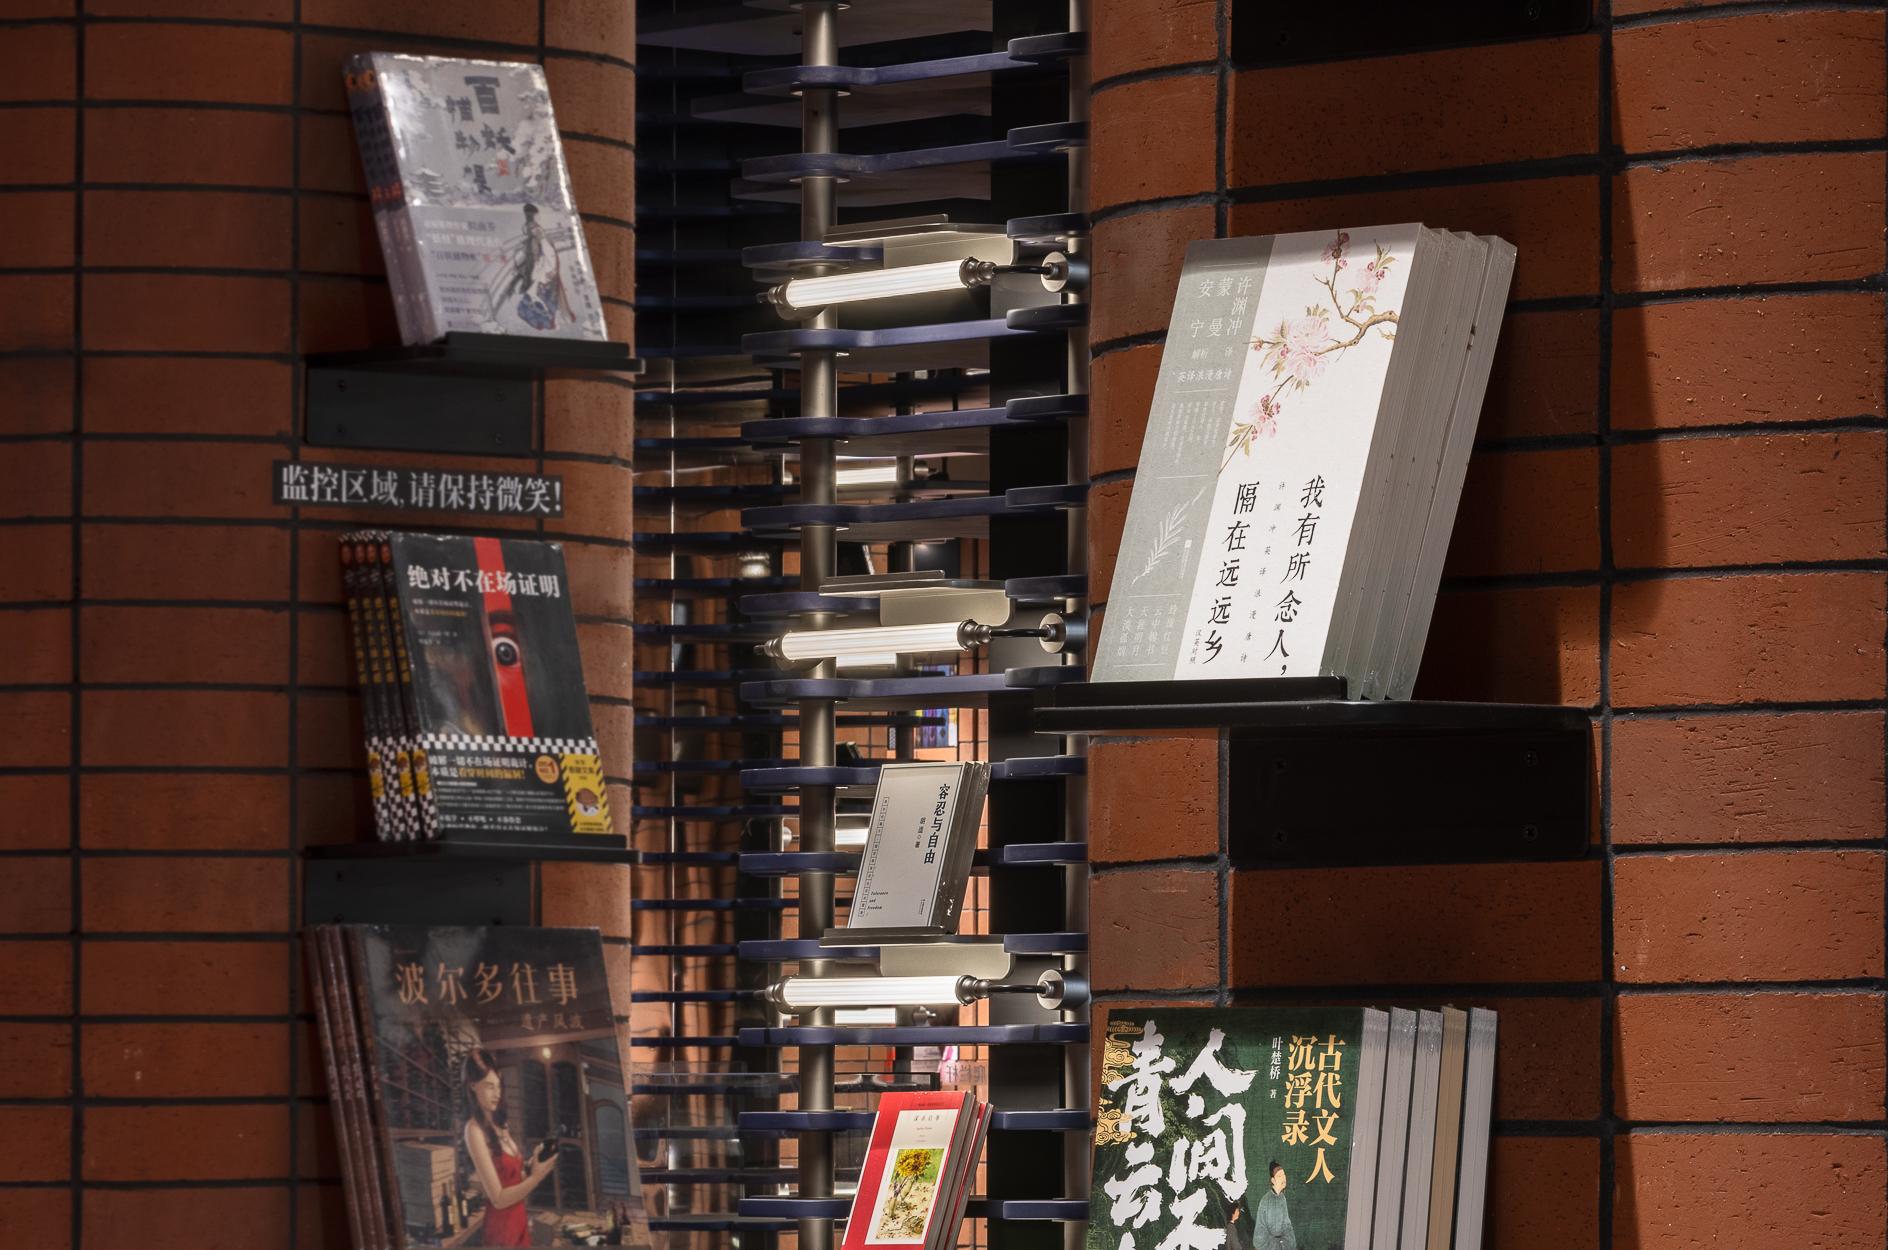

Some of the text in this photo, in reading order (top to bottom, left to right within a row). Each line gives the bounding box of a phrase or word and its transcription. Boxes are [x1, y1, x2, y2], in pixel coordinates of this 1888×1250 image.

[1227, 276, 1253, 336] 许渊冲
[407, 564, 561, 599] 绝对不在场证明
[1202, 480, 1260, 665] 隔在远远乡
[924, 783, 951, 864] 容忍与自由
[395, 961, 579, 1006] 波尔多往事
[1269, 1036, 1284, 1080] 叶楚桥
[1269, 1089, 1277, 1099] 著
[1281, 1034, 1319, 1146] 沉浮录
[1305, 1034, 1346, 1184] 古代文人
